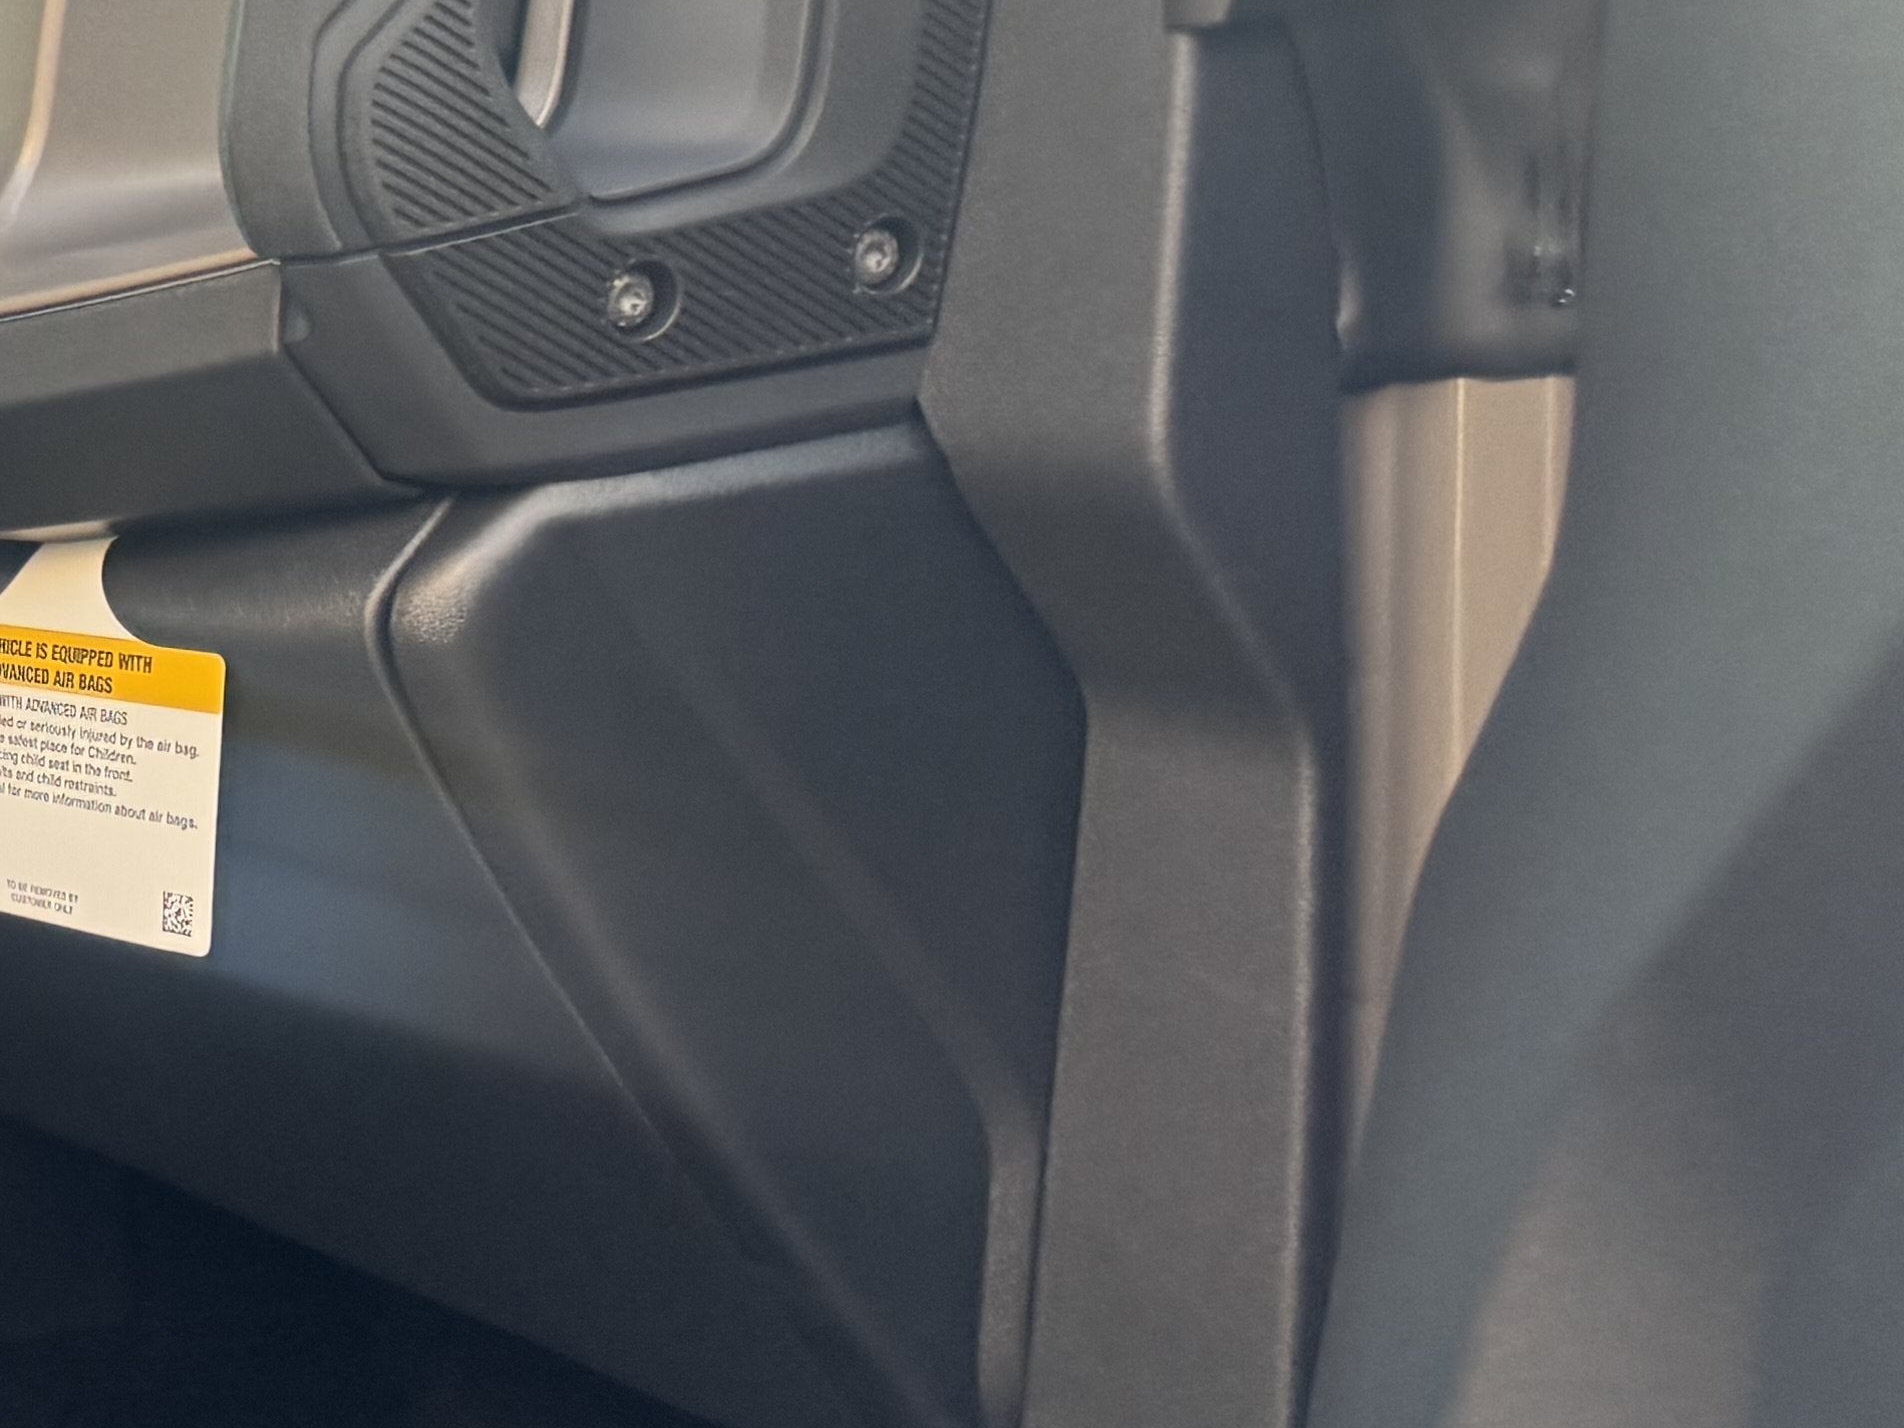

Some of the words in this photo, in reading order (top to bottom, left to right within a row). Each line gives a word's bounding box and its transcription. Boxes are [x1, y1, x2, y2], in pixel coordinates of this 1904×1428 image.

[36, 642, 48, 659] IS
[52, 645, 114, 668] EQUIPPED
[119, 652, 152, 673] WITH
[53, 670, 74, 689] AIR
[79, 674, 113, 693] BAGS
[25, 697, 76, 719] ADVANCED
[80, 706, 97, 721] AIR
[100, 709, 128, 726] BAGS
[8, 735, 37, 750] safest
[40, 741, 67, 754] place
[71, 741, 84, 756] for
[30, 722, 76, 740] seriously
[80, 727, 116, 746] injured
[120, 733, 133, 749] by
[137, 736, 153, 750] the
[157, 739, 171, 753] air
[175, 741, 199, 759] bag.
[16, 769, 34, 783] and
[37, 772, 61, 787] child
[21, 752, 45, 767] child
[49, 759, 69, 771] seat
[73, 760, 81, 773] in
[85, 763, 101, 777] the
[8, 783, 21, 797] for
[24, 789, 49, 803] more
[53, 791, 111, 813] information
[115, 804, 145, 821] about
[149, 810, 163, 823] air
[167, 812, 197, 830] bags.
